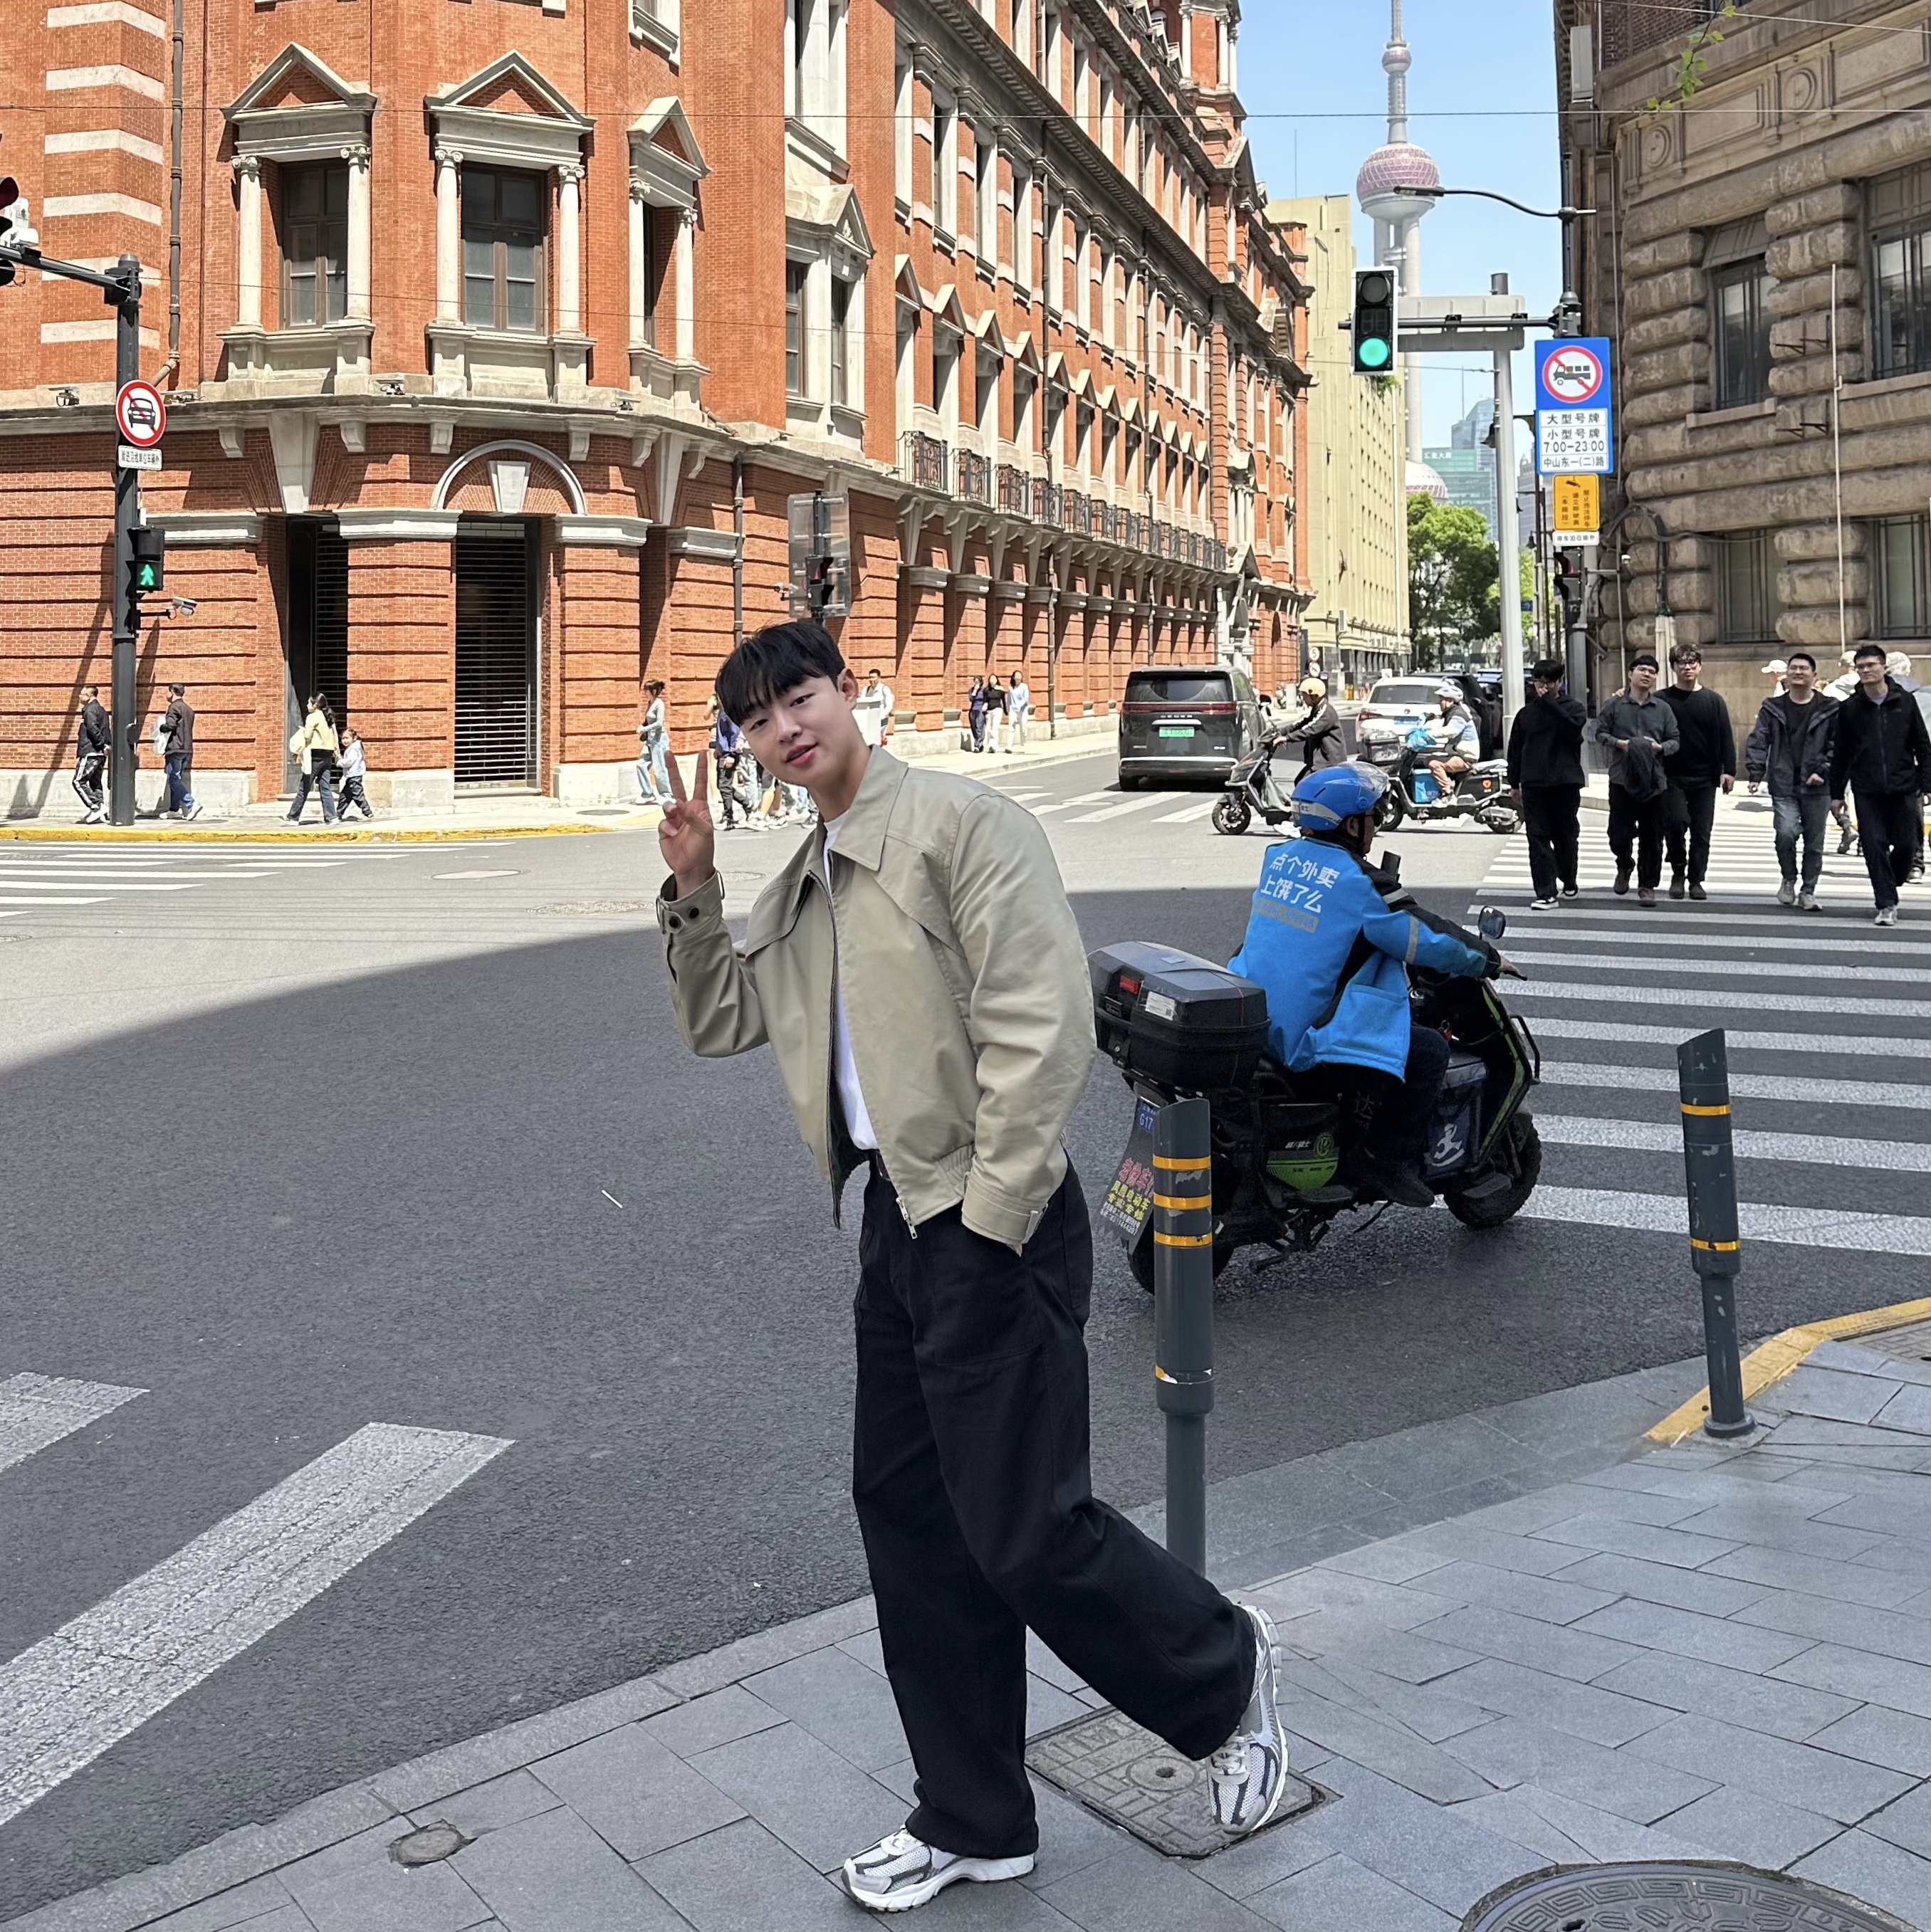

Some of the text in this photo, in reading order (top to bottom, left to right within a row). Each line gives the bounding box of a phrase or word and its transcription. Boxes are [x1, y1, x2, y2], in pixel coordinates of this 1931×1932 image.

[1547, 413, 1600, 424] 大型号牌
[1547, 429, 1600, 440] 小型号牌
[1269, 853, 1341, 889] 点个外卖
[1260, 874, 1324, 913] 上饿了么
